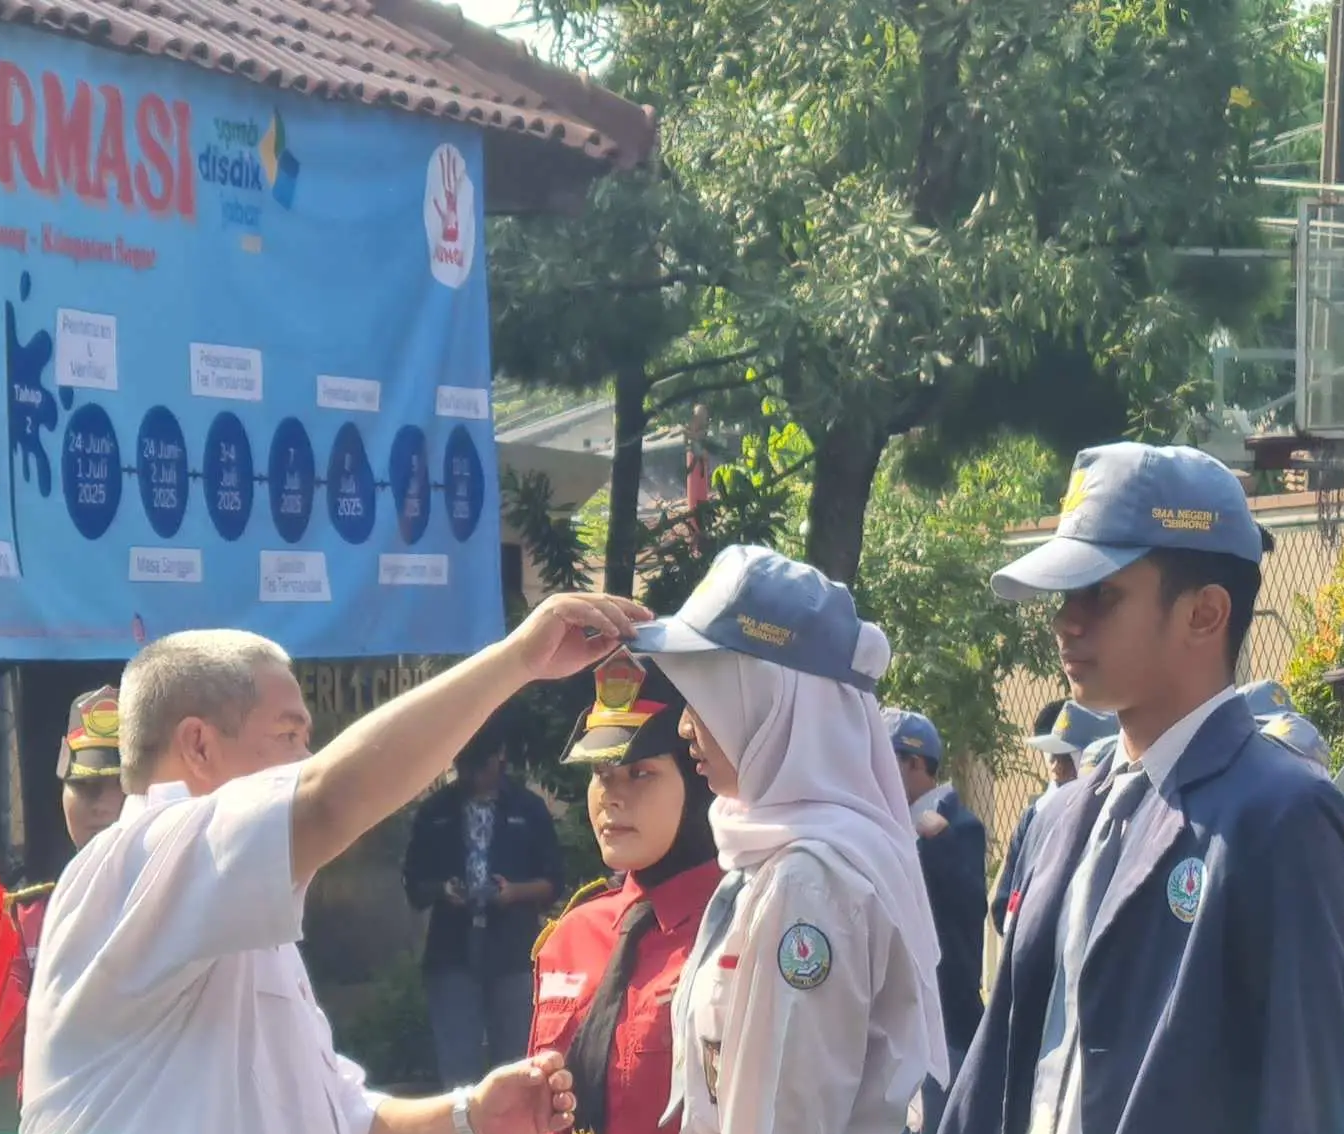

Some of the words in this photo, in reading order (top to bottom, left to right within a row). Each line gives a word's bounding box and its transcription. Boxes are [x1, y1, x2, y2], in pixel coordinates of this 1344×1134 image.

[198, 143, 263, 191] disdik
[13, 383, 43, 408] Tahap
[25, 415, 33, 435] 2
[68, 432, 82, 453] 24
[287, 447, 296, 466] 7
[76, 459, 83, 478] 1
[85, 459, 108, 480] Juli
[151, 464, 157, 483] 2
[77, 483, 106, 504] 2025
[152, 488, 177, 509] 2025
[216, 491, 242, 511] 2025
[337, 497, 364, 517] 2025
[1151, 507, 1175, 519] SMA
[1177, 509, 1212, 521] NEGERI
[1161, 519, 1210, 530] CIBINONG
[299, 662, 342, 713] ERI
